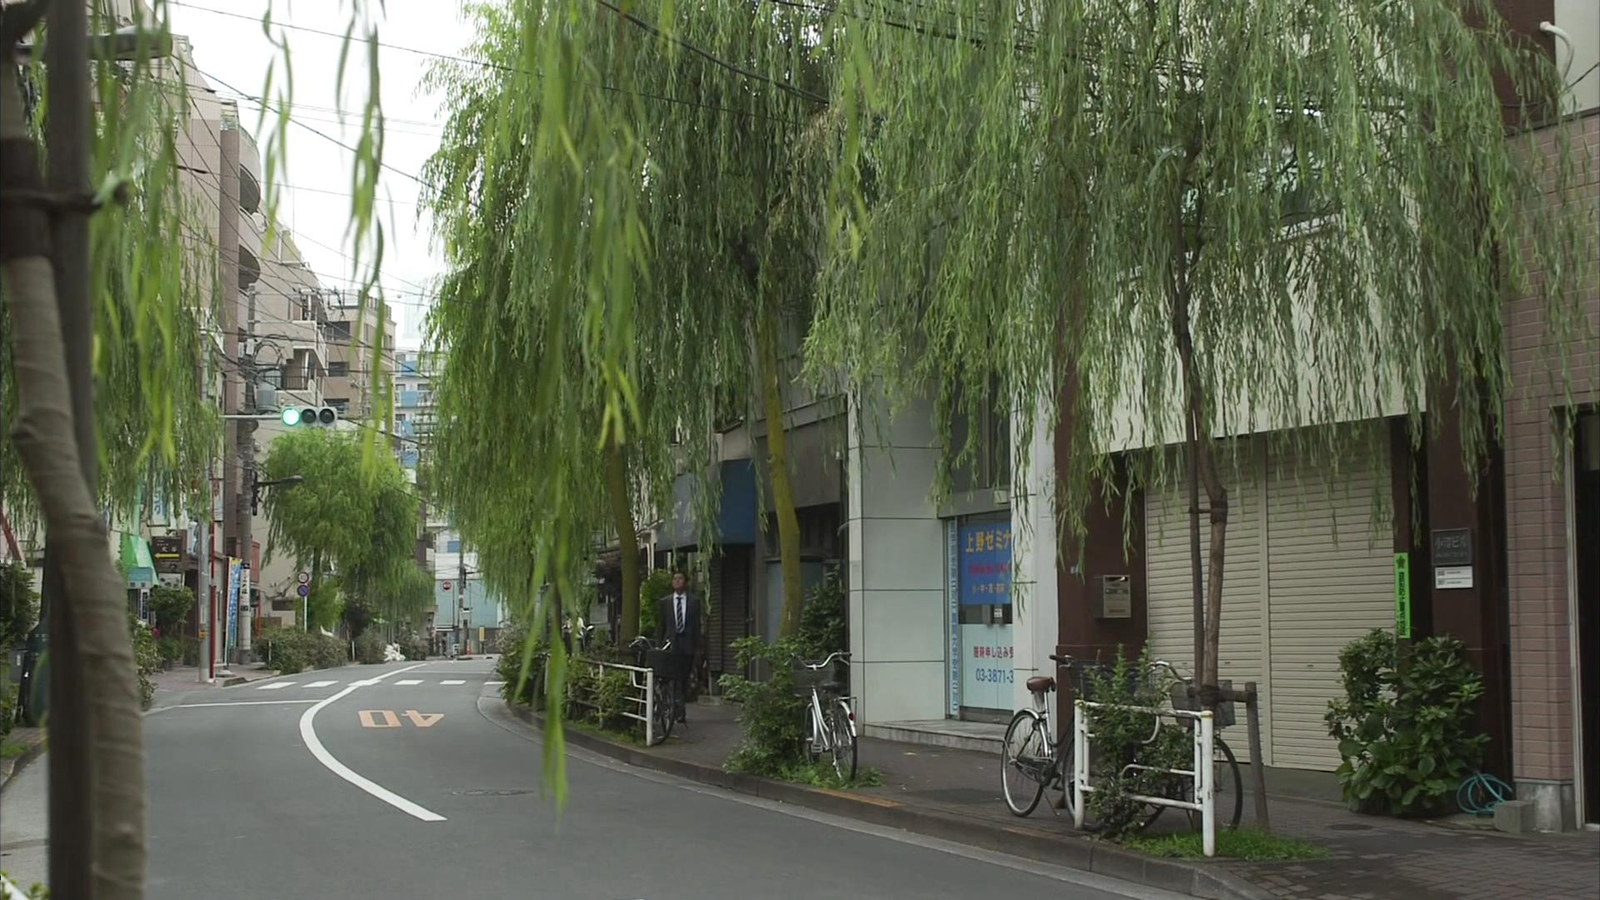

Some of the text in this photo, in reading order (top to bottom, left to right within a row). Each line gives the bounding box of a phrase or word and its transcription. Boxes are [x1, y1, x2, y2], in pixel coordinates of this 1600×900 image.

[966, 530, 1012, 553] 上野ゼミナ
[976, 668, 1014, 683] 03-3871-3
[358, 710, 445, 727] 40
